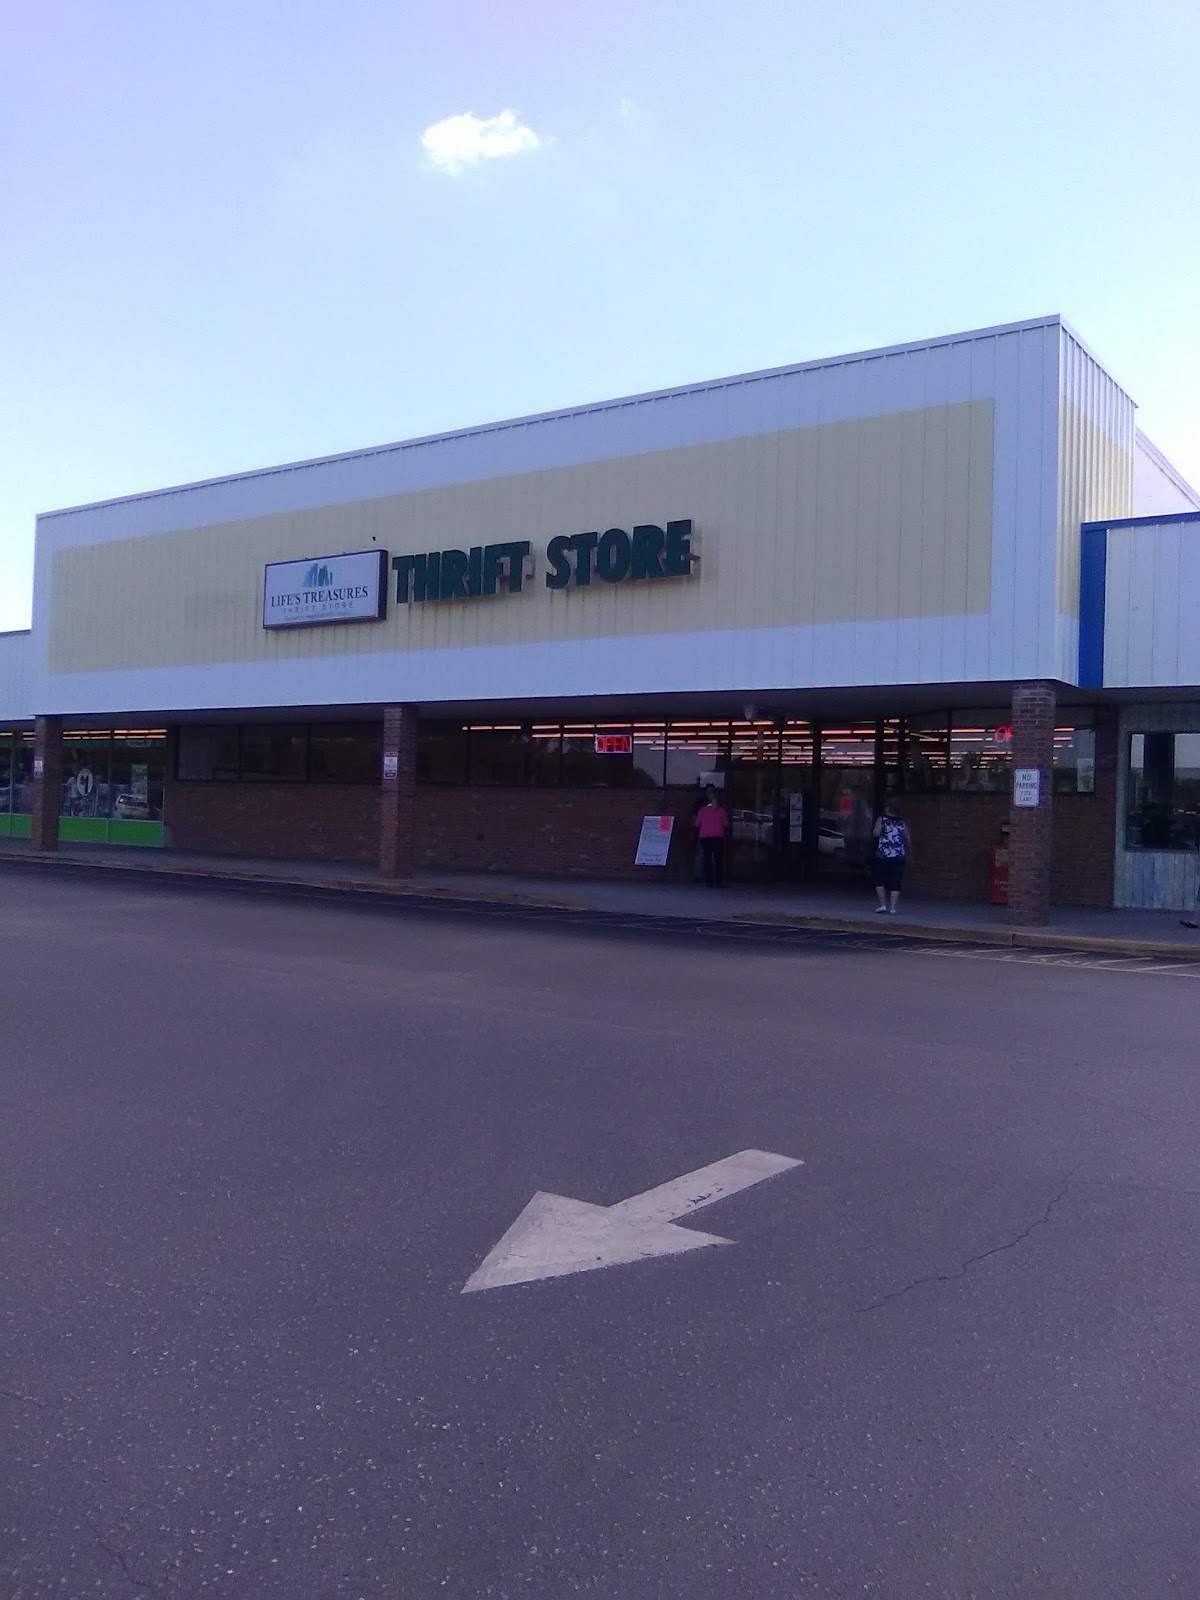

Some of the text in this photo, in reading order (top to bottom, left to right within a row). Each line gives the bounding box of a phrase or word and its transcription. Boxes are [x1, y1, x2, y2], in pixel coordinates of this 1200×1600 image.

[392, 519, 692, 604] THRIFT STORE
[271, 586, 369, 607] LIFE'S TREASURES
[283, 601, 354, 614] THRIFT STORE
[597, 736, 631, 752] OPEN
